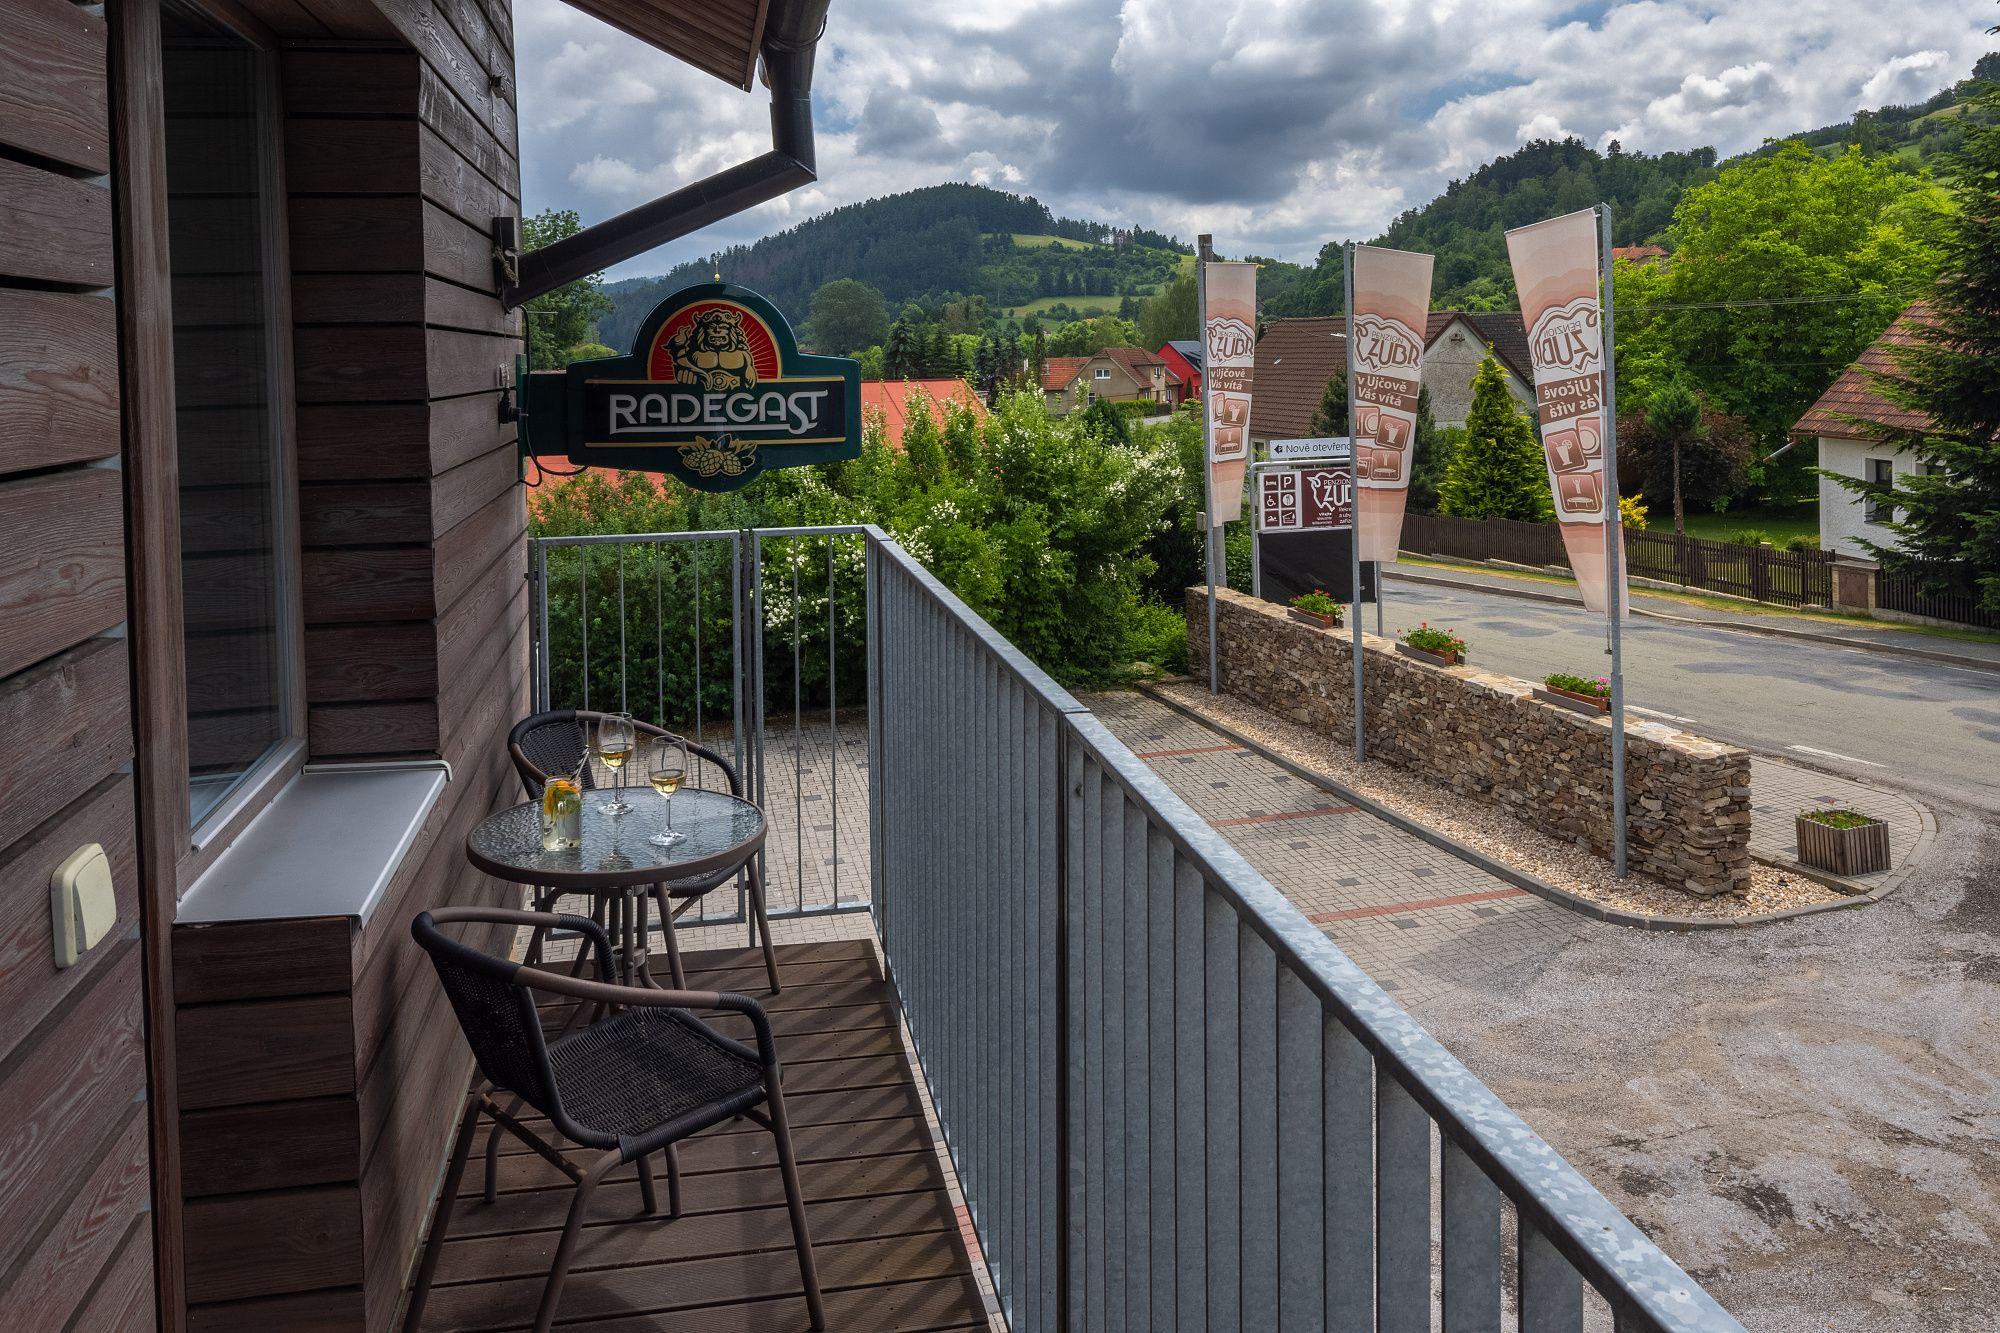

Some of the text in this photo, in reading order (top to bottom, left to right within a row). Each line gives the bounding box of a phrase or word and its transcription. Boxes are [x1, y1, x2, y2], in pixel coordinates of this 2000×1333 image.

[1371, 331, 1404, 344] PENZION
[1217, 336, 1254, 358] ZUBR
[1368, 338, 1420, 367] ZUBR
[1223, 380, 1243, 390] vítá
[1357, 376, 1407, 393] v Ujčově
[1358, 387, 1402, 407] Vás vítá
[609, 389, 829, 435] RADEGAST
[1286, 443, 1310, 453] Nově
[1284, 477, 1292, 488] P
